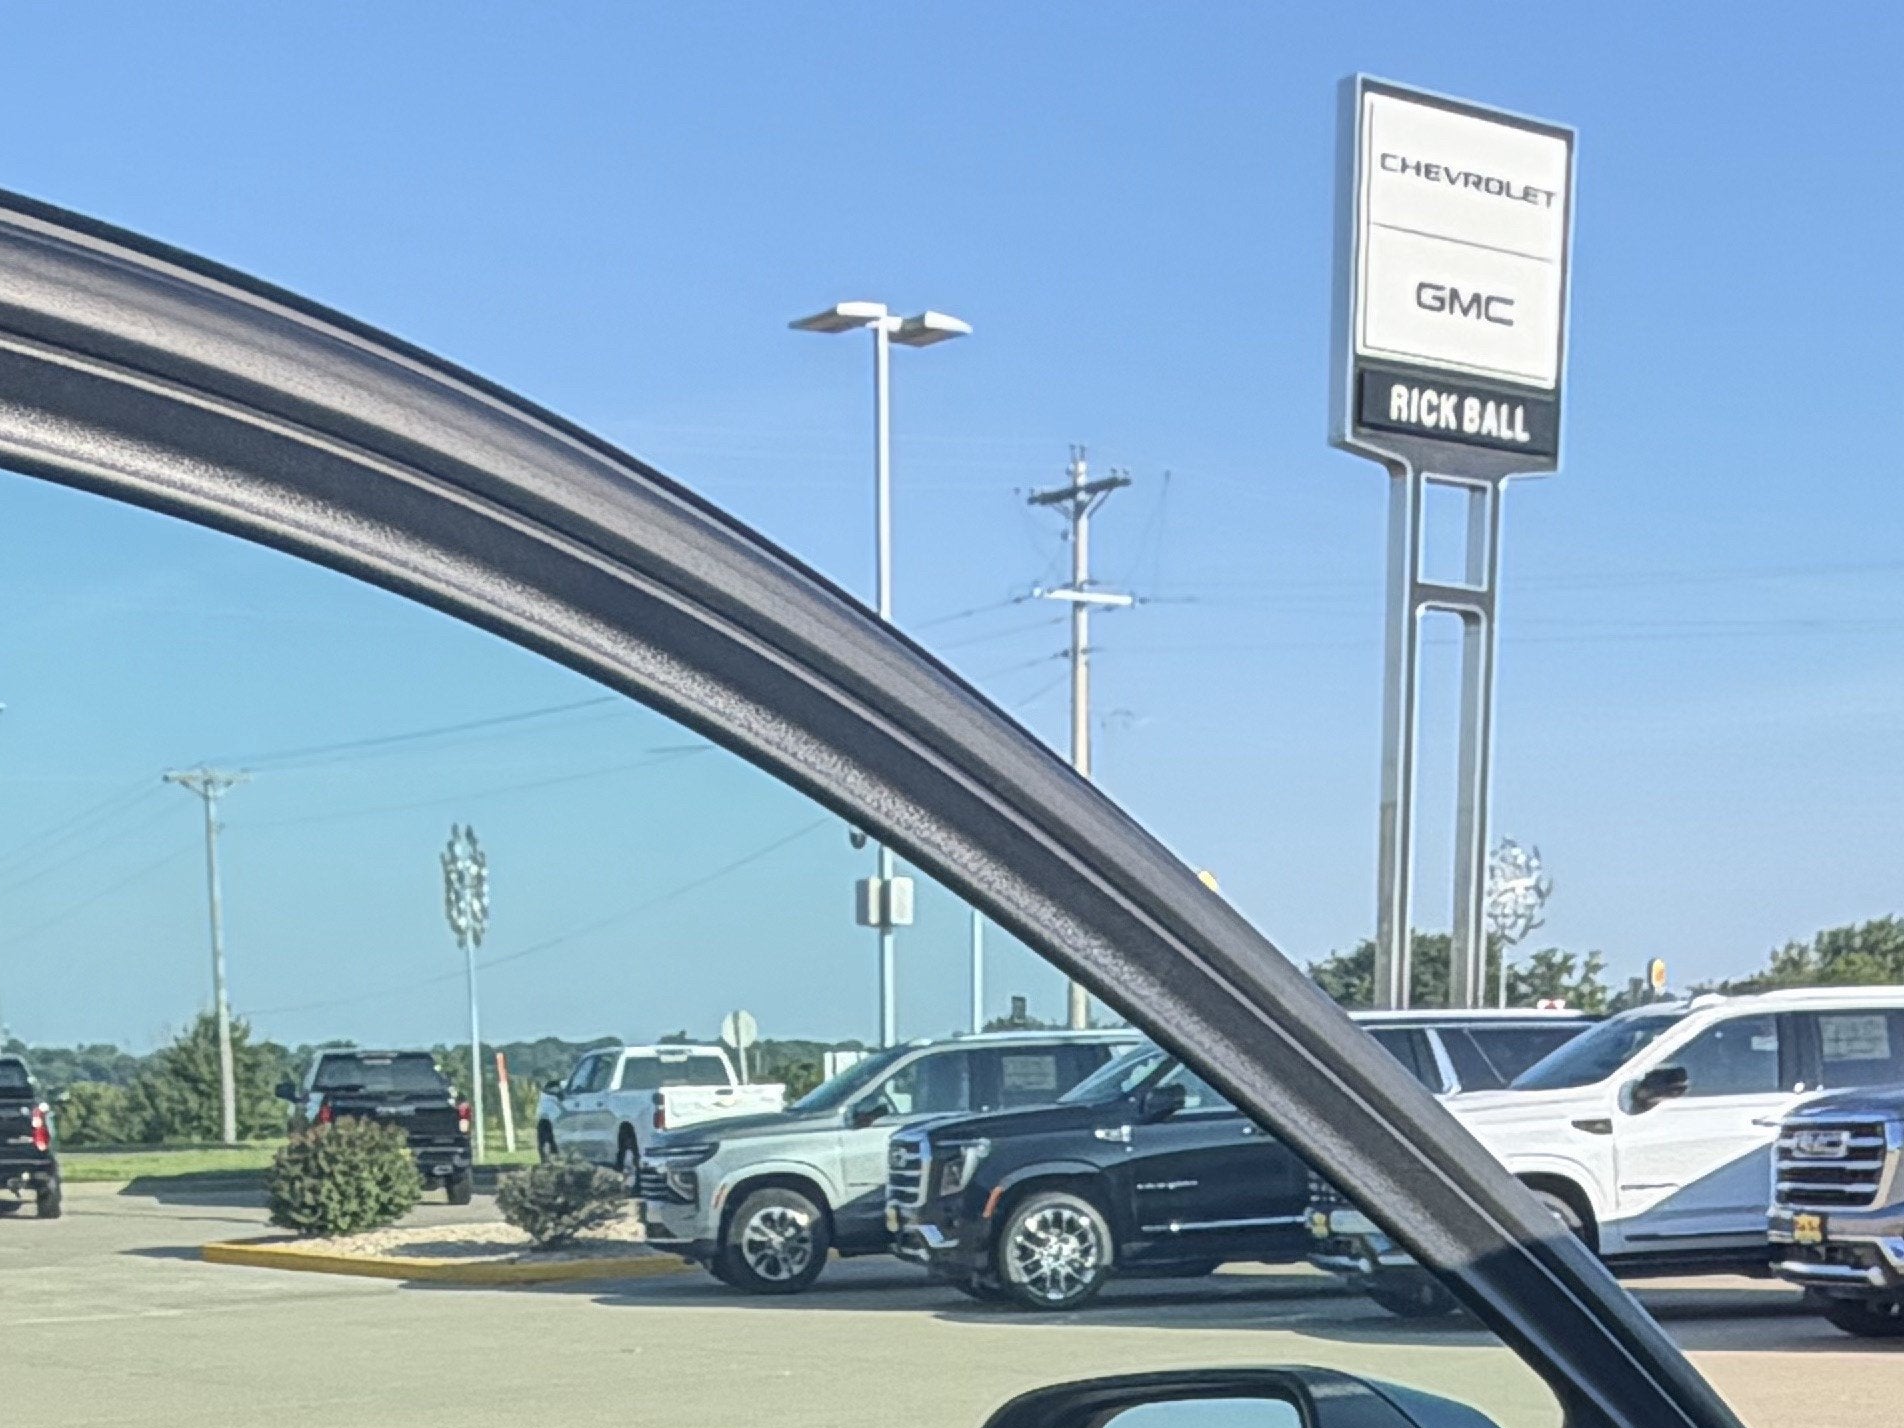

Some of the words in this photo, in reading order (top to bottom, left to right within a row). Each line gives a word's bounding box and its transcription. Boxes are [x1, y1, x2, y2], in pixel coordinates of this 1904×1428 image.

[1379, 151, 1557, 210] CHEVROLET
[1414, 280, 1516, 327] GMC
[1388, 383, 1459, 433] RICK
[1462, 392, 1531, 443] BALL
